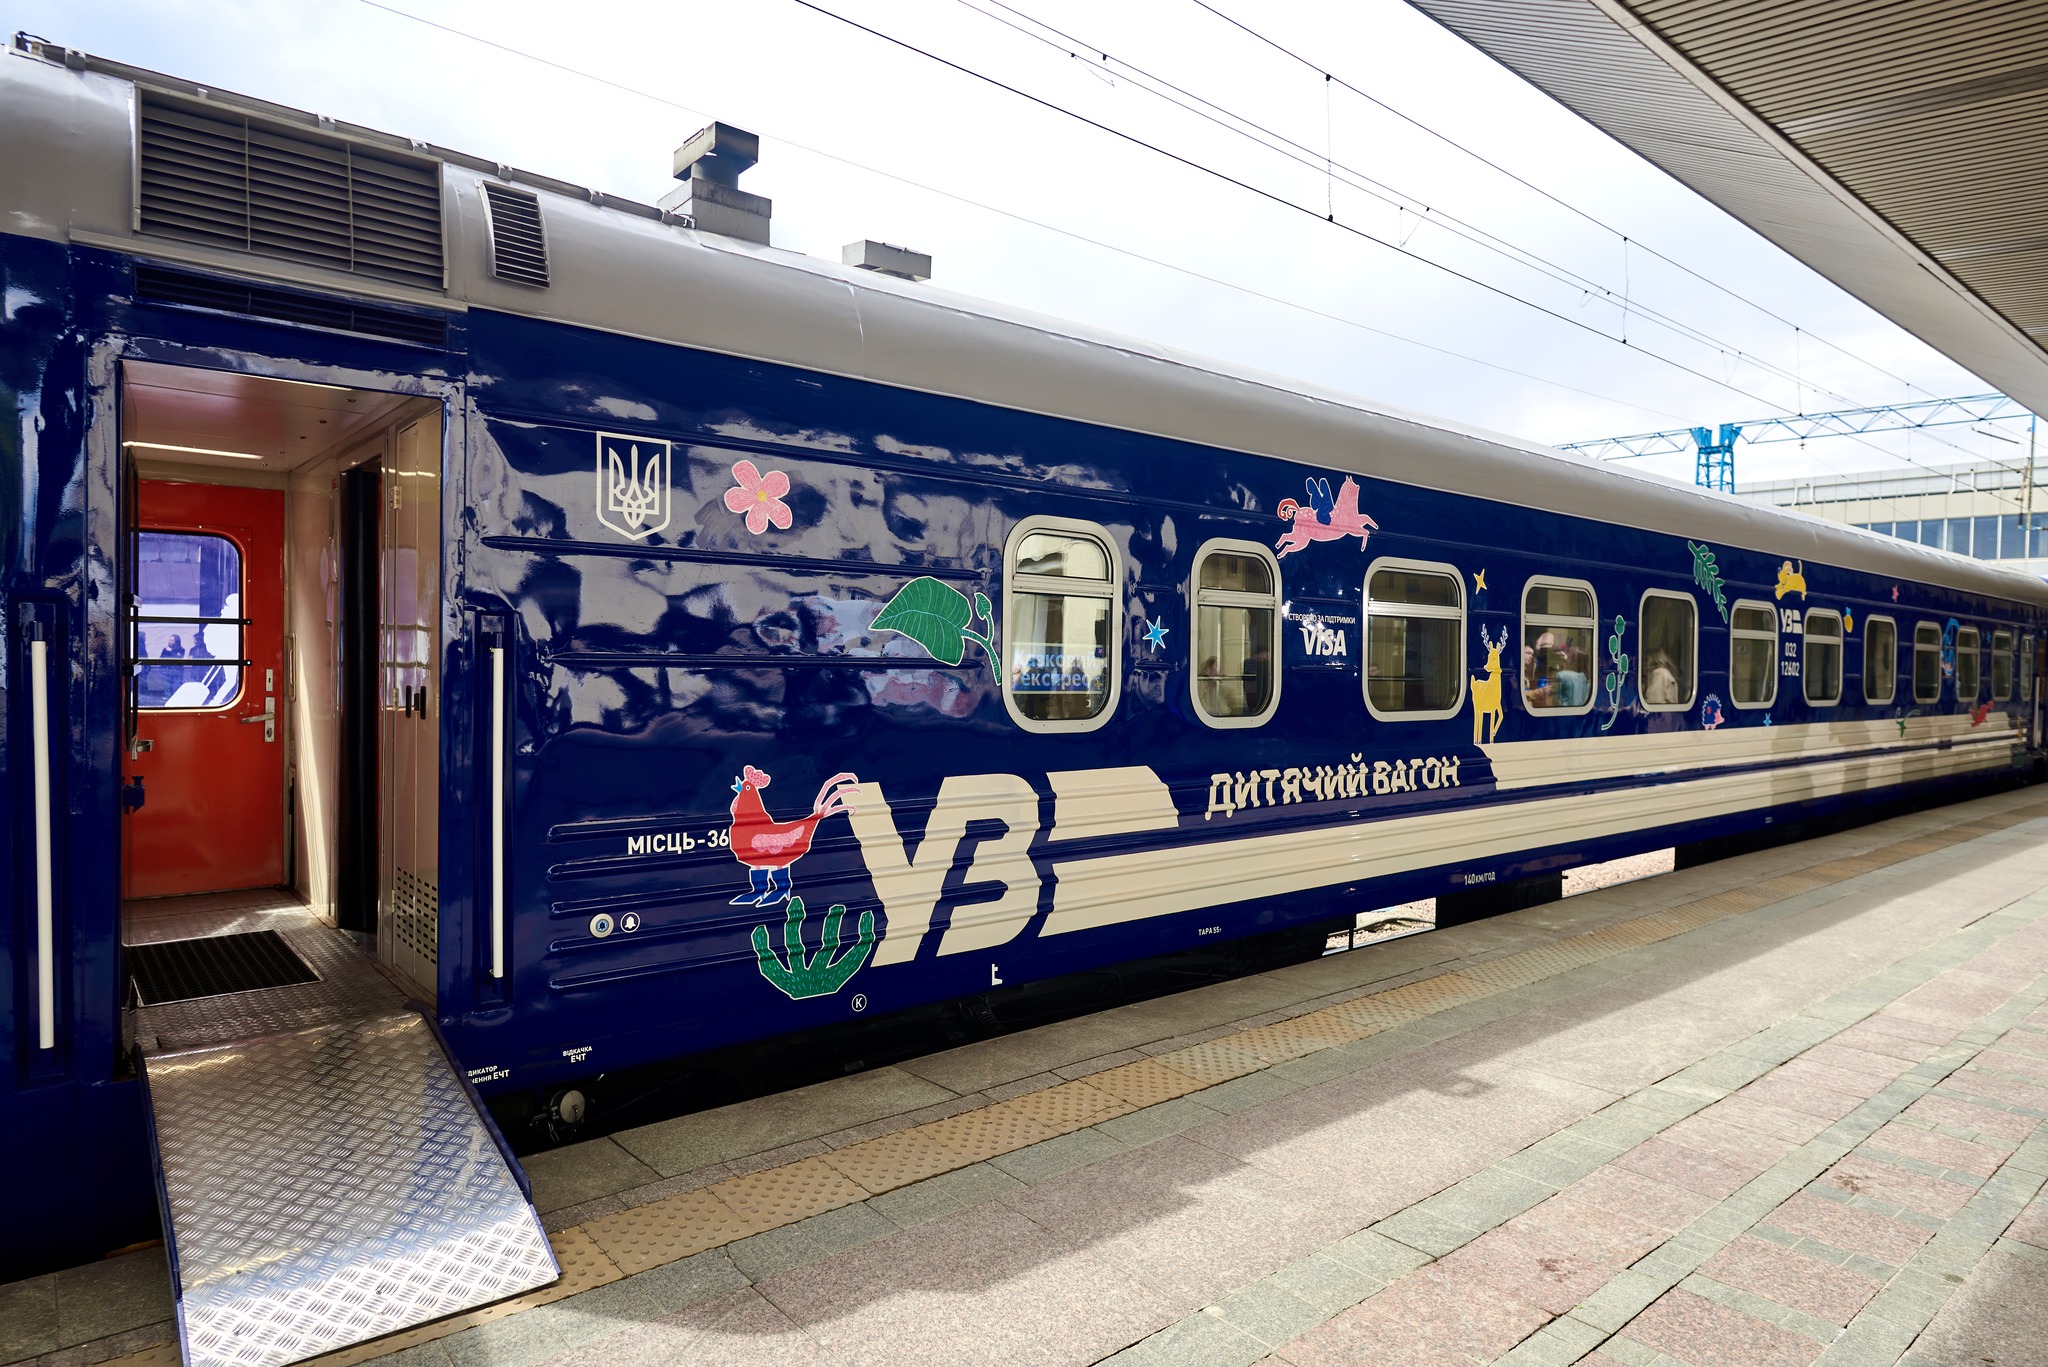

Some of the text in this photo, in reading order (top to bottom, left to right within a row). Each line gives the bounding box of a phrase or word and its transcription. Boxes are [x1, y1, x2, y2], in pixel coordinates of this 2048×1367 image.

[1288, 612, 1317, 622] СТВОРО
[1299, 627, 1347, 656] VISA
[1785, 642, 1797, 657] 032
[1781, 661, 1800, 676] 12602
[1205, 752, 1461, 821] ДИТЯЧИЙ ВАГОН
[627, 828, 731, 855] МІСЦЬ-36
[1198, 927, 1213, 936] ТАРА
[562, 1045, 593, 1057] ВІДКАЧКА
[570, 1053, 587, 1063] ЕЧТ
[466, 1065, 498, 1077] ДИКАТОР
[493, 1069, 510, 1080] ЕЧТ
